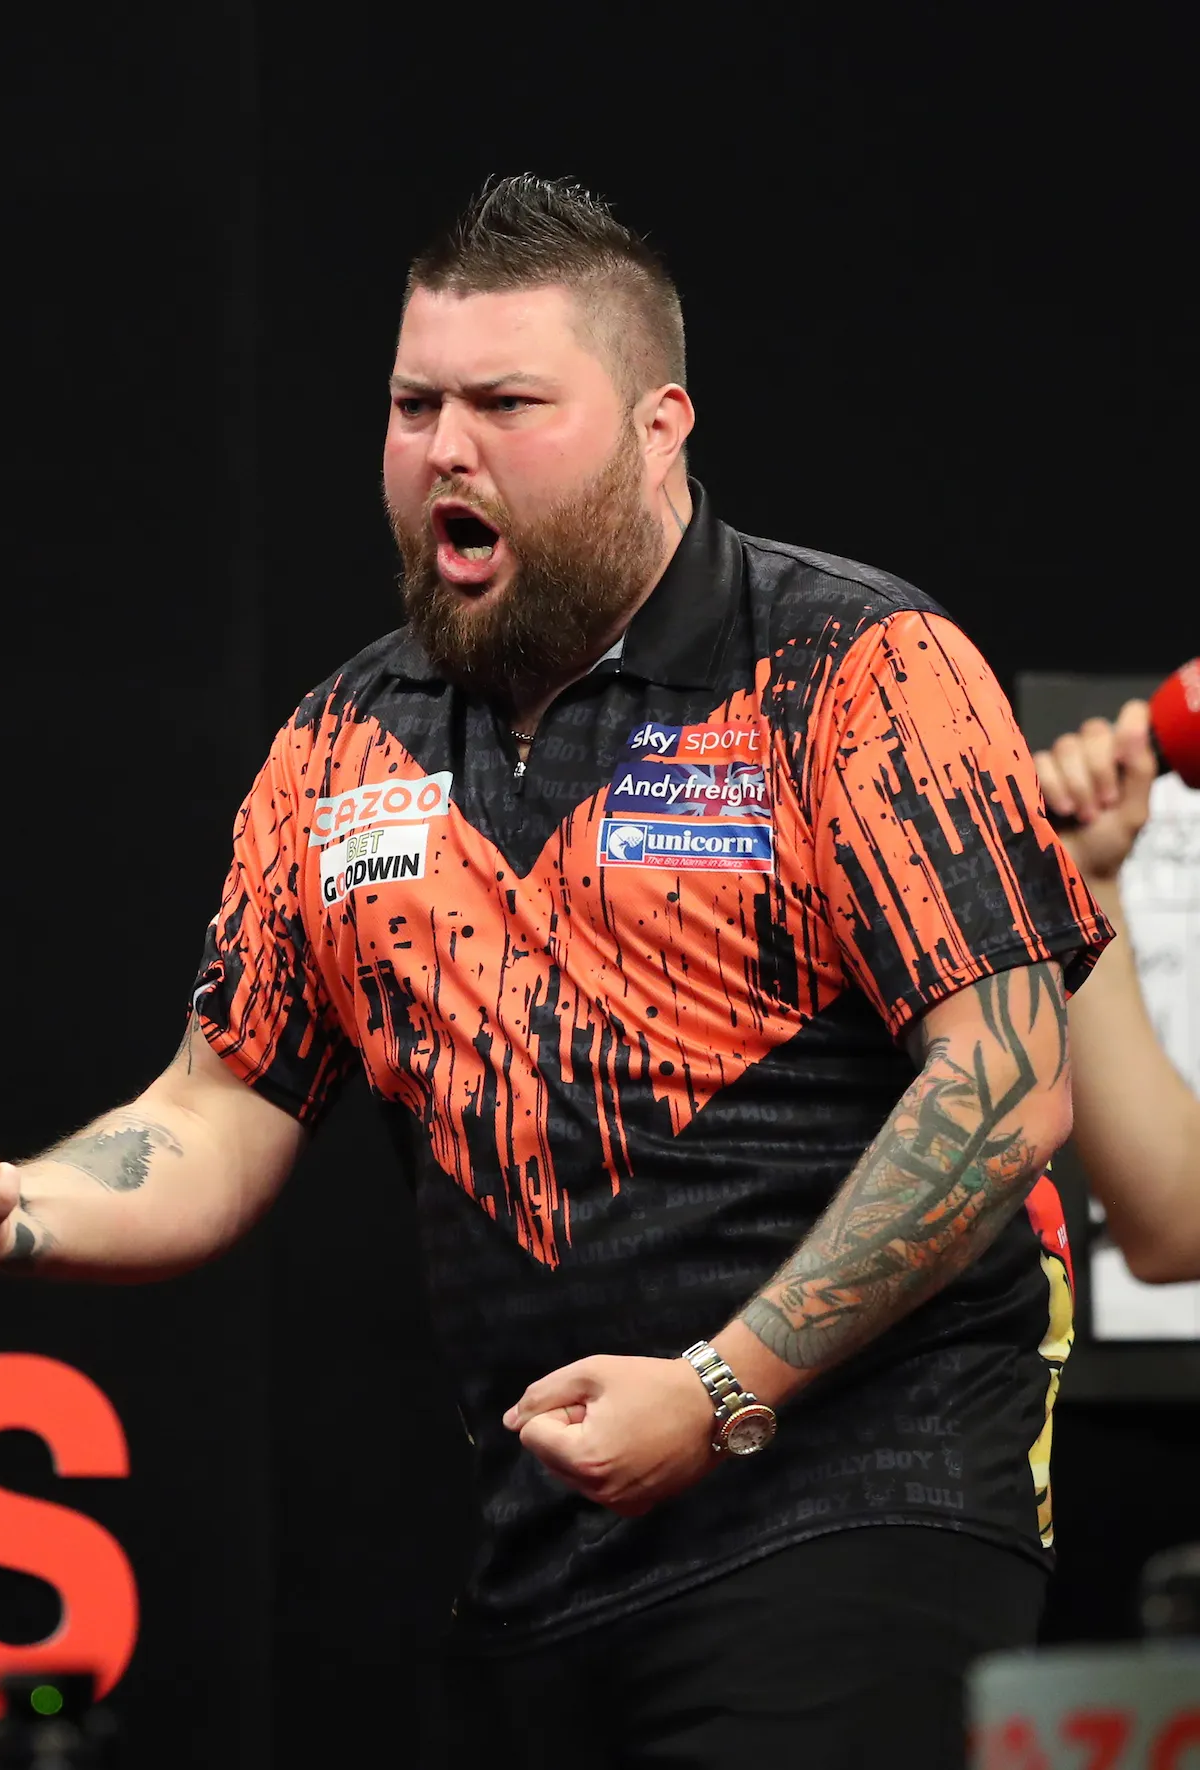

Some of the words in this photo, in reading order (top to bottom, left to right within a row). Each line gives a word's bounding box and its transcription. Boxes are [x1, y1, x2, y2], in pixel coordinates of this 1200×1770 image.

[630, 724, 677, 754] sky
[684, 728, 762, 755] sport
[613, 773, 767, 807] Andyfreight
[309, 782, 443, 838] CAZOO
[345, 829, 385, 864] BET
[647, 829, 755, 854] unicorn
[323, 853, 421, 903] GOODWIN
[646, 856, 661, 865] The
[664, 857, 680, 867] Big
[680, 858, 707, 867] Name
